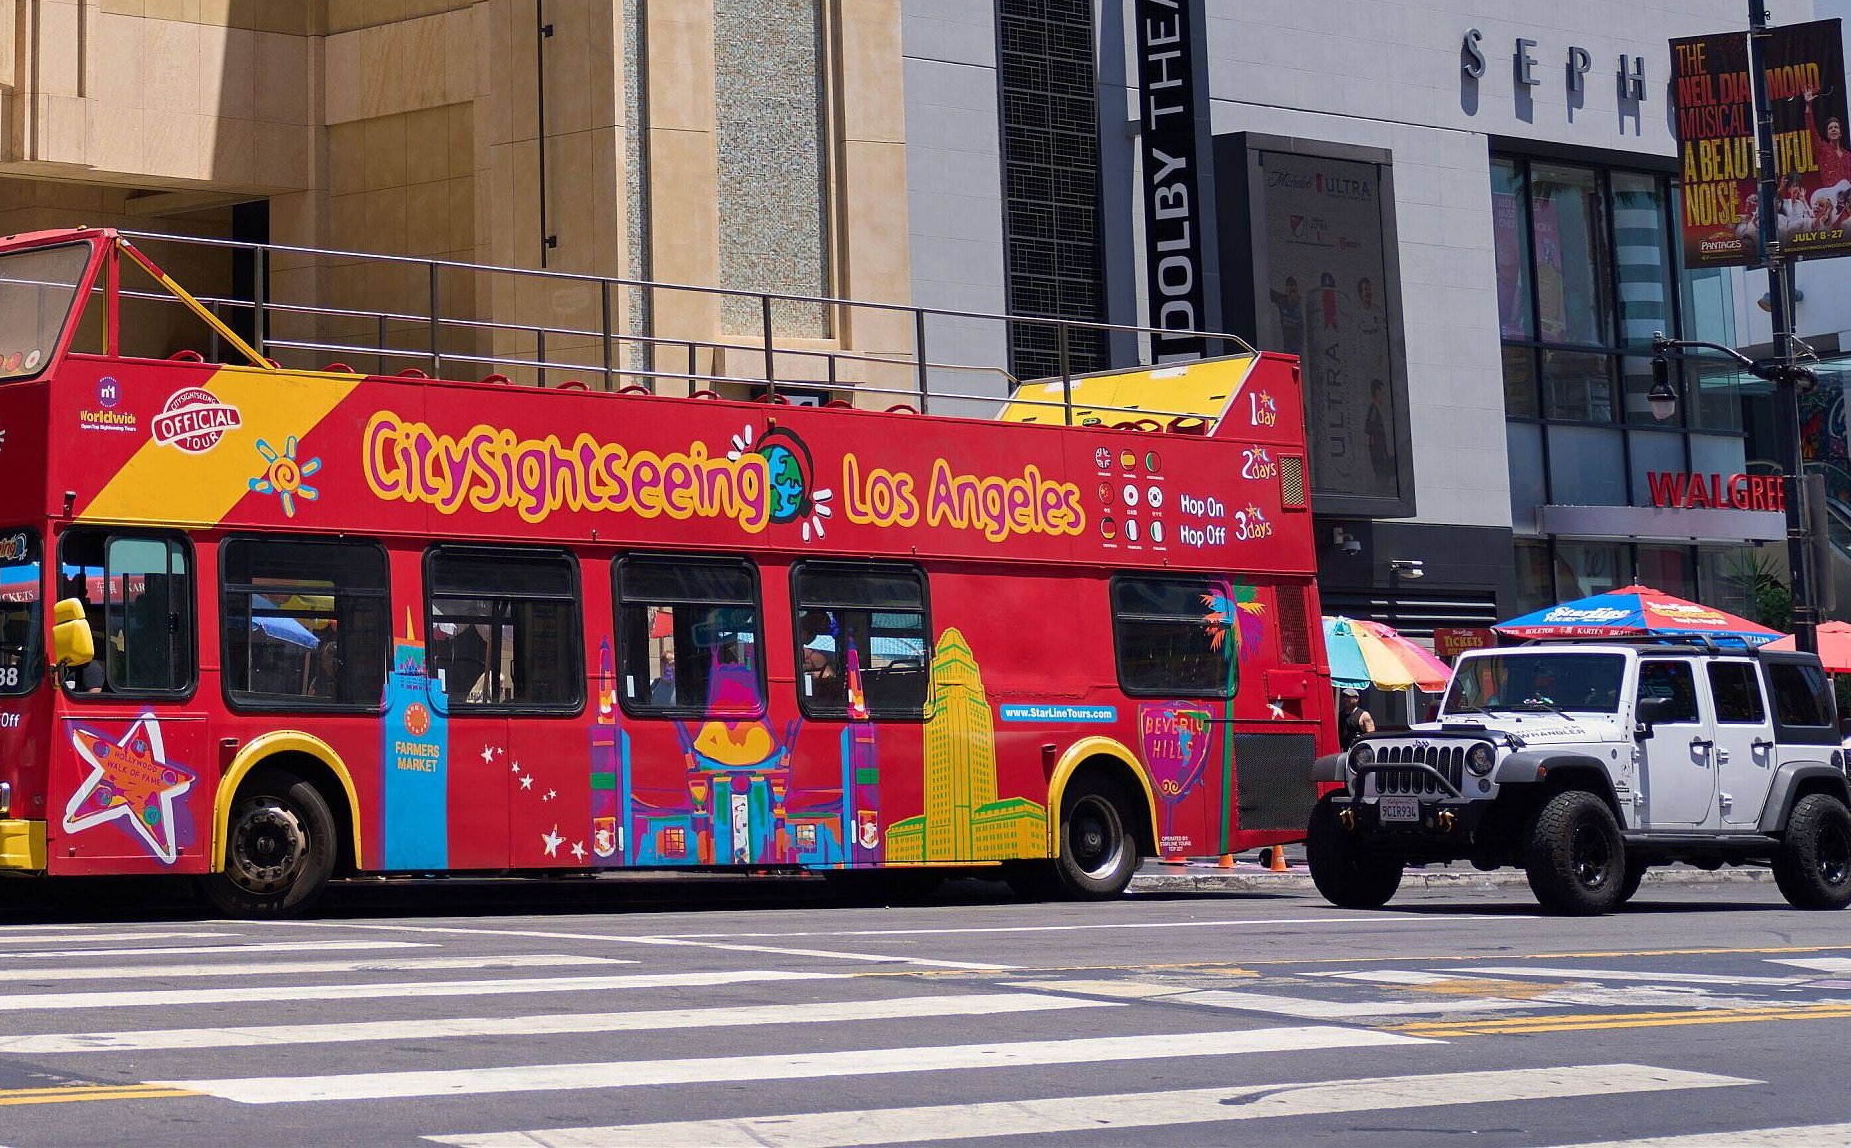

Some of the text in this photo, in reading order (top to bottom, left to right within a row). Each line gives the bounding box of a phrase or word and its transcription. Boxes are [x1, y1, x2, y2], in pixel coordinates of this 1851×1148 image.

[1461, 28, 1647, 101] SEPH
[1676, 42, 1708, 76] THE
[1677, 62, 1821, 109] NEIL DIAMOND
[1679, 102, 1749, 139] MUSICAL
[1684, 130, 1820, 183] A BEAUTIFUL
[1325, 178, 1372, 197] ULTRA
[1685, 180, 1741, 227] NOISE
[1153, 148, 1195, 339] DOLBY
[1701, 239, 1742, 251] PANTAGES
[1793, 229, 1844, 243] JULY 8-27
[1249, 392, 1276, 427] 1 day
[1326, 342, 1347, 458] ULTRA
[80, 410, 137, 424] Worldwide
[162, 409, 237, 438] OFFICIAL
[186, 432, 219, 449] TOUR
[363, 409, 771, 534] CitySightseeing
[1242, 450, 1277, 480] 2 days
[843, 452, 1087, 543] Los Angeles
[1647, 471, 1787, 511] WALGREE
[1180, 493, 1224, 517] Hop On
[1180, 524, 1226, 547] Hop Off
[1235, 511, 1272, 541] 3 days
[1443, 635, 1484, 648] TICKETS
[1577, 627, 1604, 635] KARTEN
[1, 713, 20, 728] Off
[1005, 707, 1112, 719] www.StarLineTours.com
[1145, 716, 1205, 736] BEVERLY
[114, 751, 158, 773] HOLLYWOOD
[395, 741, 440, 758] FARMERS
[1152, 739, 1194, 761] HILLS
[107, 760, 161, 786] WALK OF FAME
[397, 757, 438, 773] MARKET
